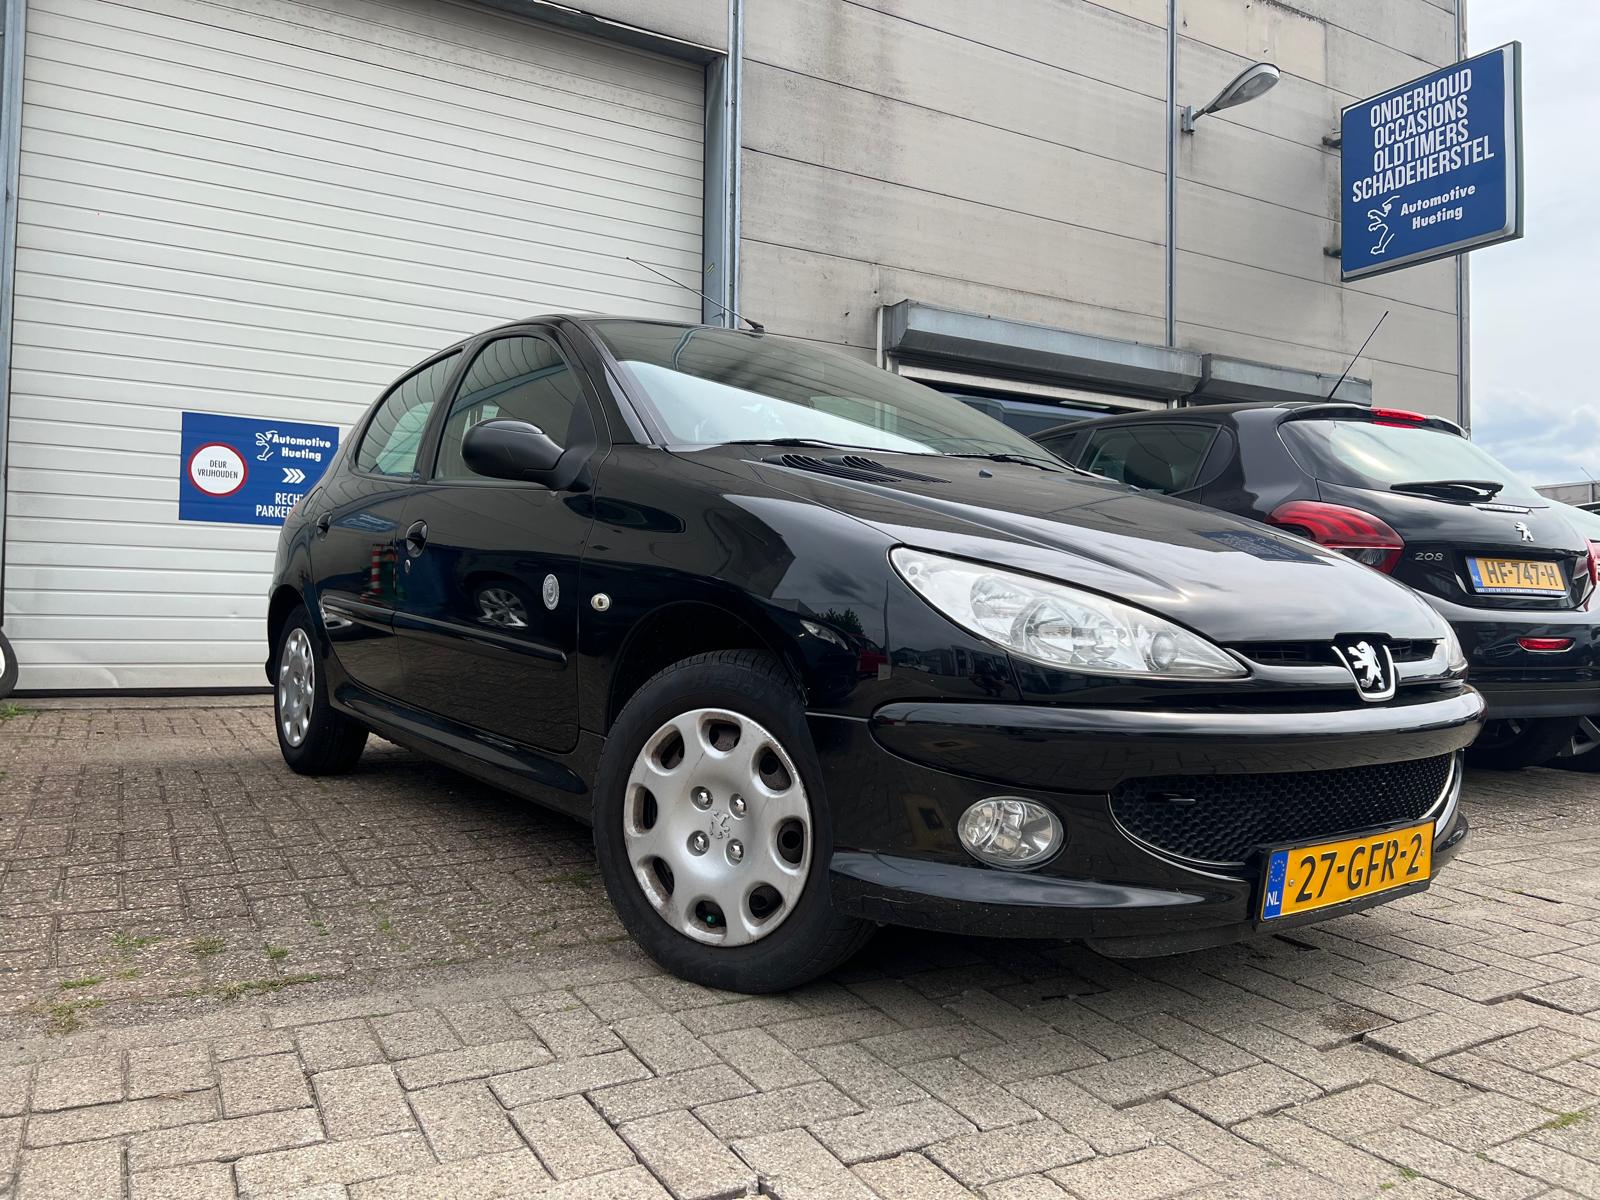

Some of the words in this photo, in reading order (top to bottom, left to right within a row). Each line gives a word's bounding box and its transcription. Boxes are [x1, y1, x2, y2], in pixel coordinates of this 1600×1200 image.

[1370, 68, 1472, 128] ONDERHOUD
[1374, 94, 1468, 149] OCCASIONS
[1373, 118, 1469, 173] OLDTIMERS
[1352, 135, 1495, 203] SCHADEHERSTEL
[1400, 184, 1476, 217] Automotive
[1412, 206, 1463, 230] Hueting
[272, 434, 331, 449] Automotive
[209, 459, 227, 469] DEUR
[281, 447, 322, 463] Hueting
[197, 468, 239, 480] VRIJHOUDEN
[1414, 552, 1444, 561] 208
[1484, 561, 1559, 586] HF-747-H
[1295, 833, 1423, 903] 27-GFR-2
[1266, 891, 1280, 907] NL
